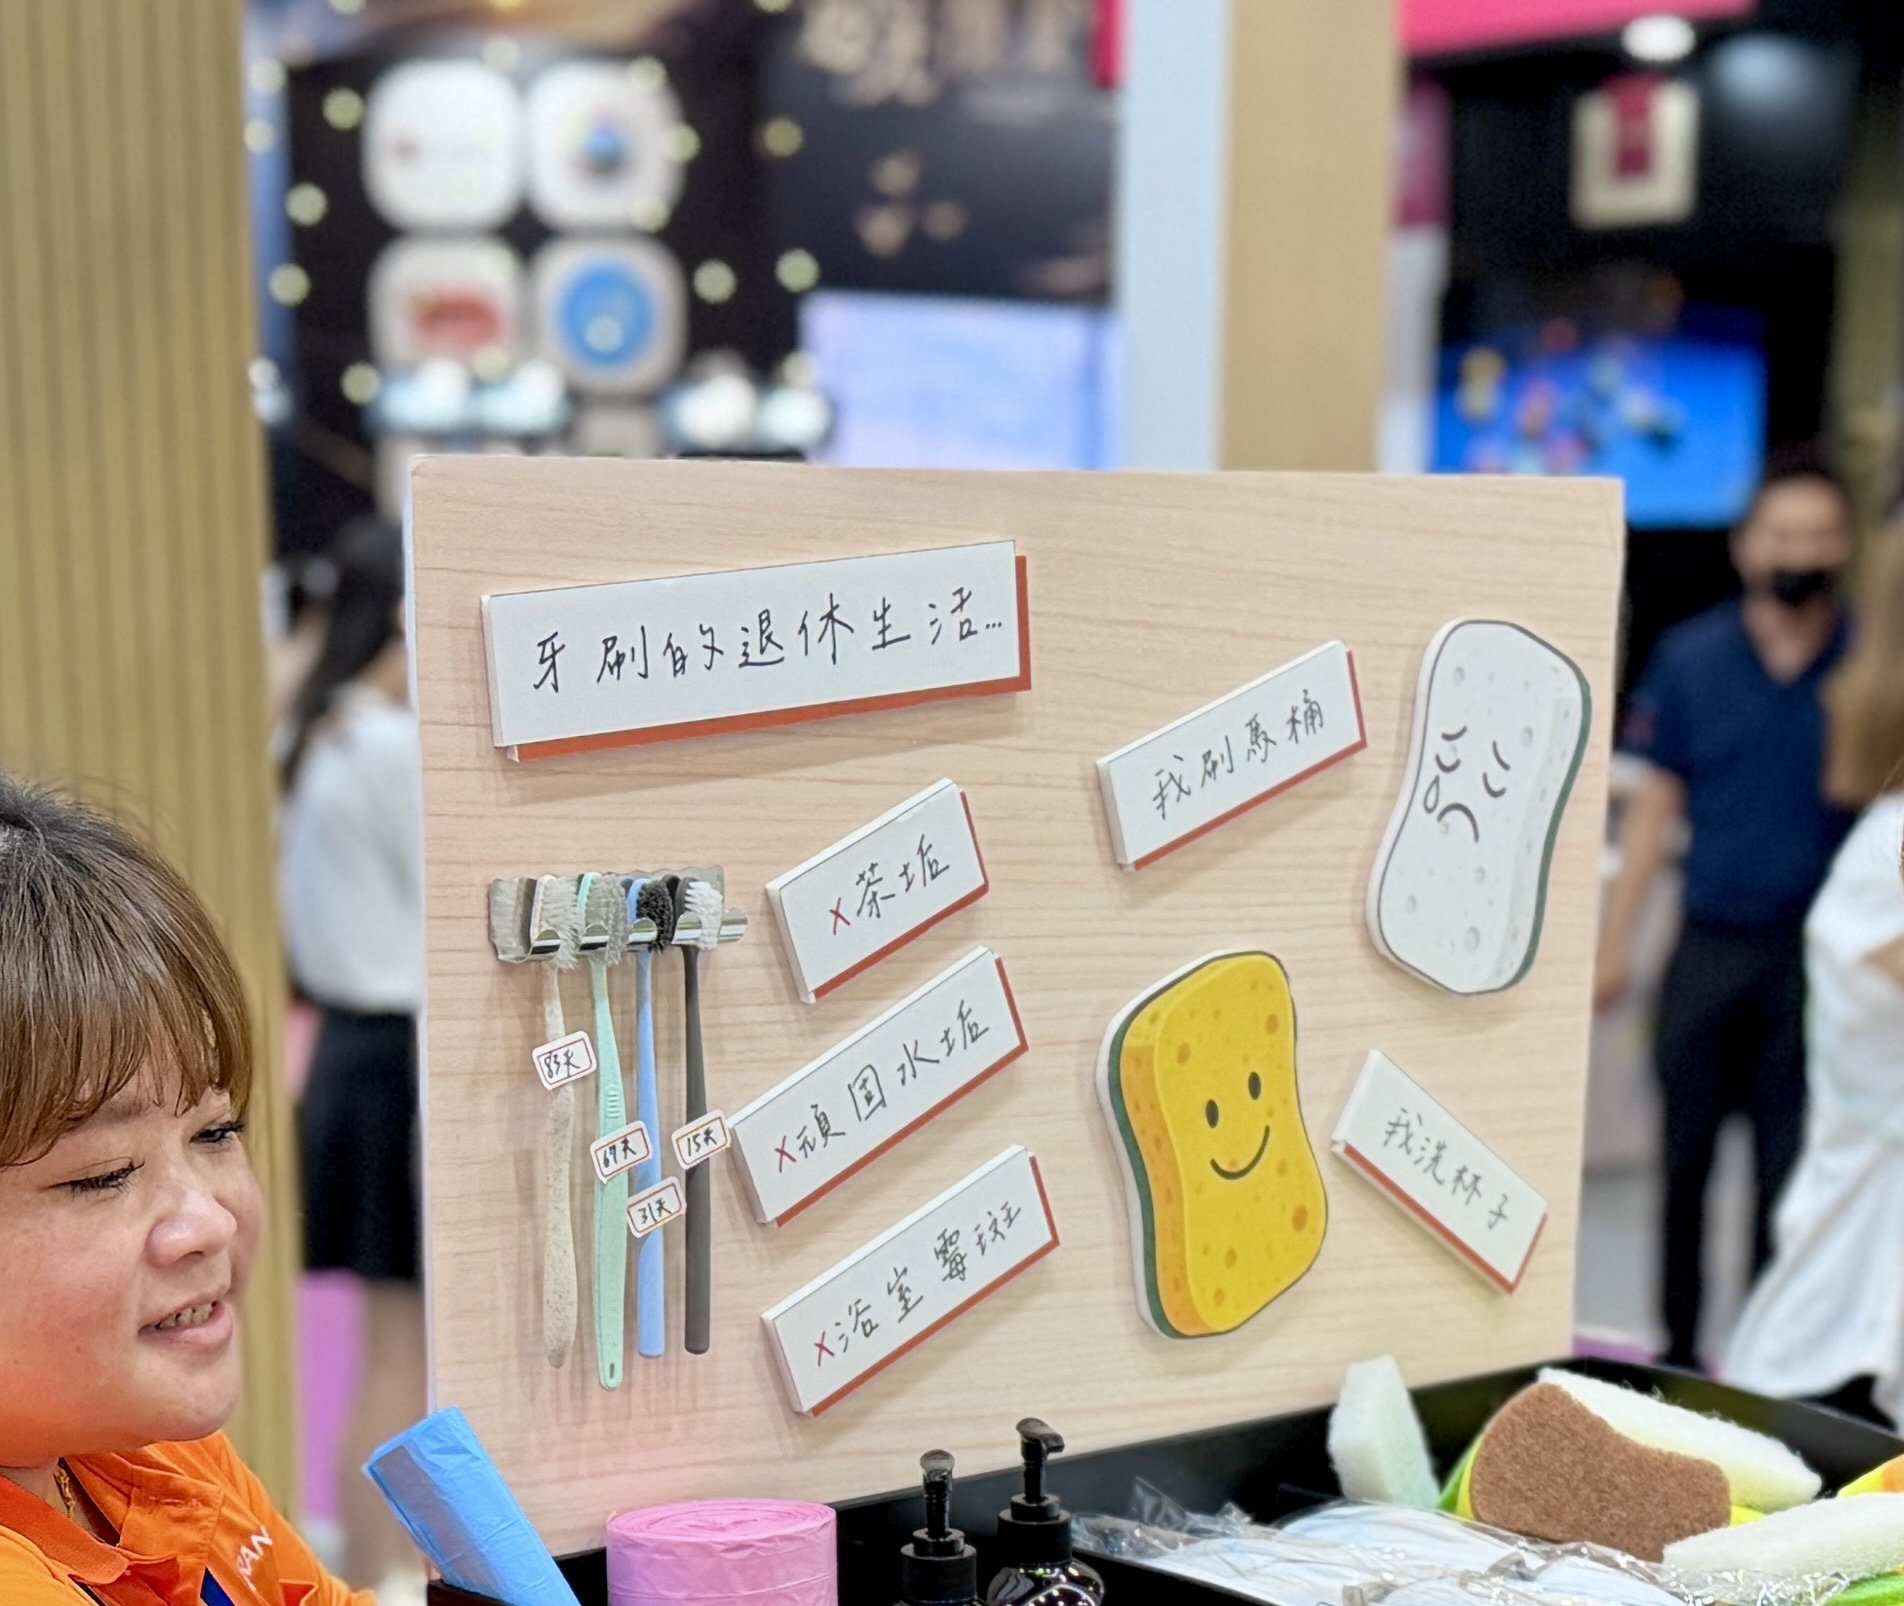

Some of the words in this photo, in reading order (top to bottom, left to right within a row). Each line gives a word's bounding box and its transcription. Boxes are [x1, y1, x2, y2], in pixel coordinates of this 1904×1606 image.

[1153, 689, 1324, 820] 我刷馬桶
[1386, 1107, 1510, 1230] 我洗杯子
